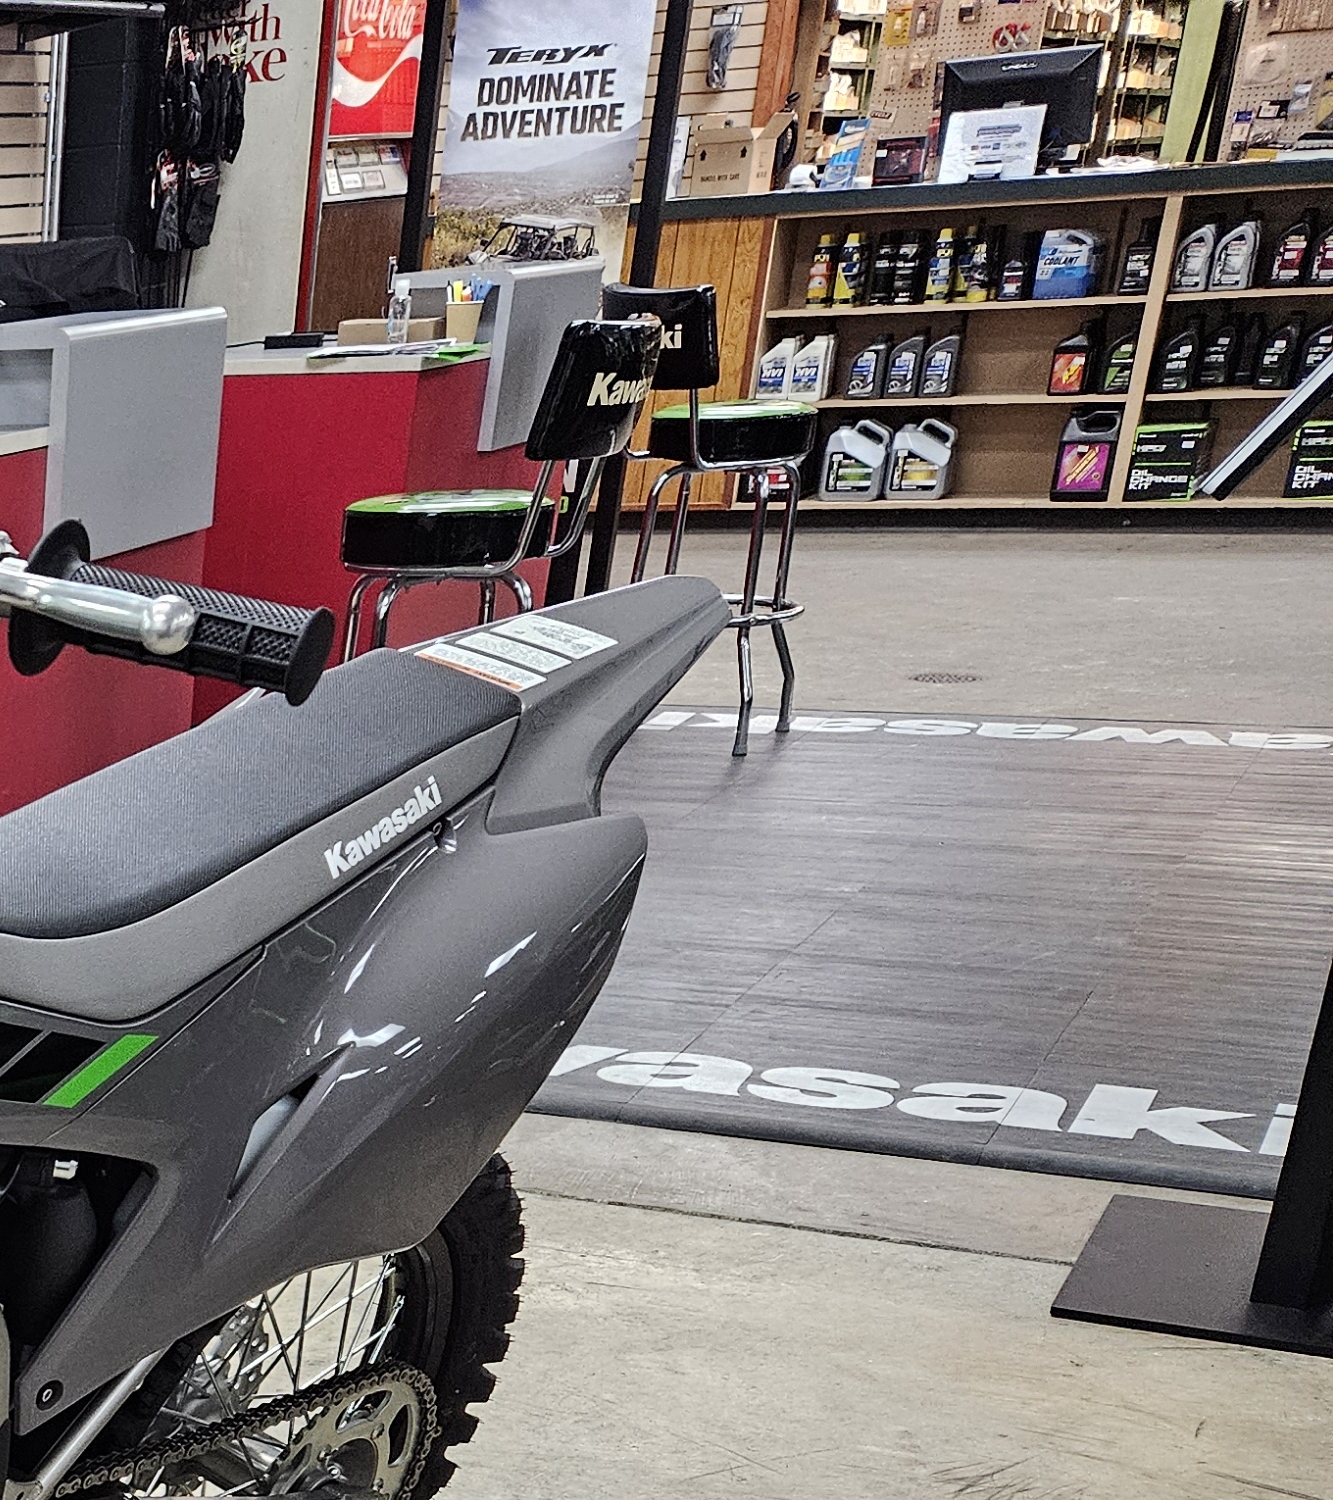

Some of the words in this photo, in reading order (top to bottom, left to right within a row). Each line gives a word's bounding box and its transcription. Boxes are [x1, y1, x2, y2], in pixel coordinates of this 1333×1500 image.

[208, 3, 282, 47] wth
[477, 68, 617, 107] DOMINATE
[460, 102, 625, 142] ADVENTURE
[1044, 256, 1080, 266] COOLANT
[587, 372, 654, 406] Kawa
[1130, 475, 1188, 484] CHANGE
[1131, 469, 1153, 477] OIL
[1293, 473, 1333, 482] CHAN
[1294, 466, 1321, 474] OIL
[323, 775, 442, 880] Kawasaki
[548, 1045, 1295, 1157] asaki
